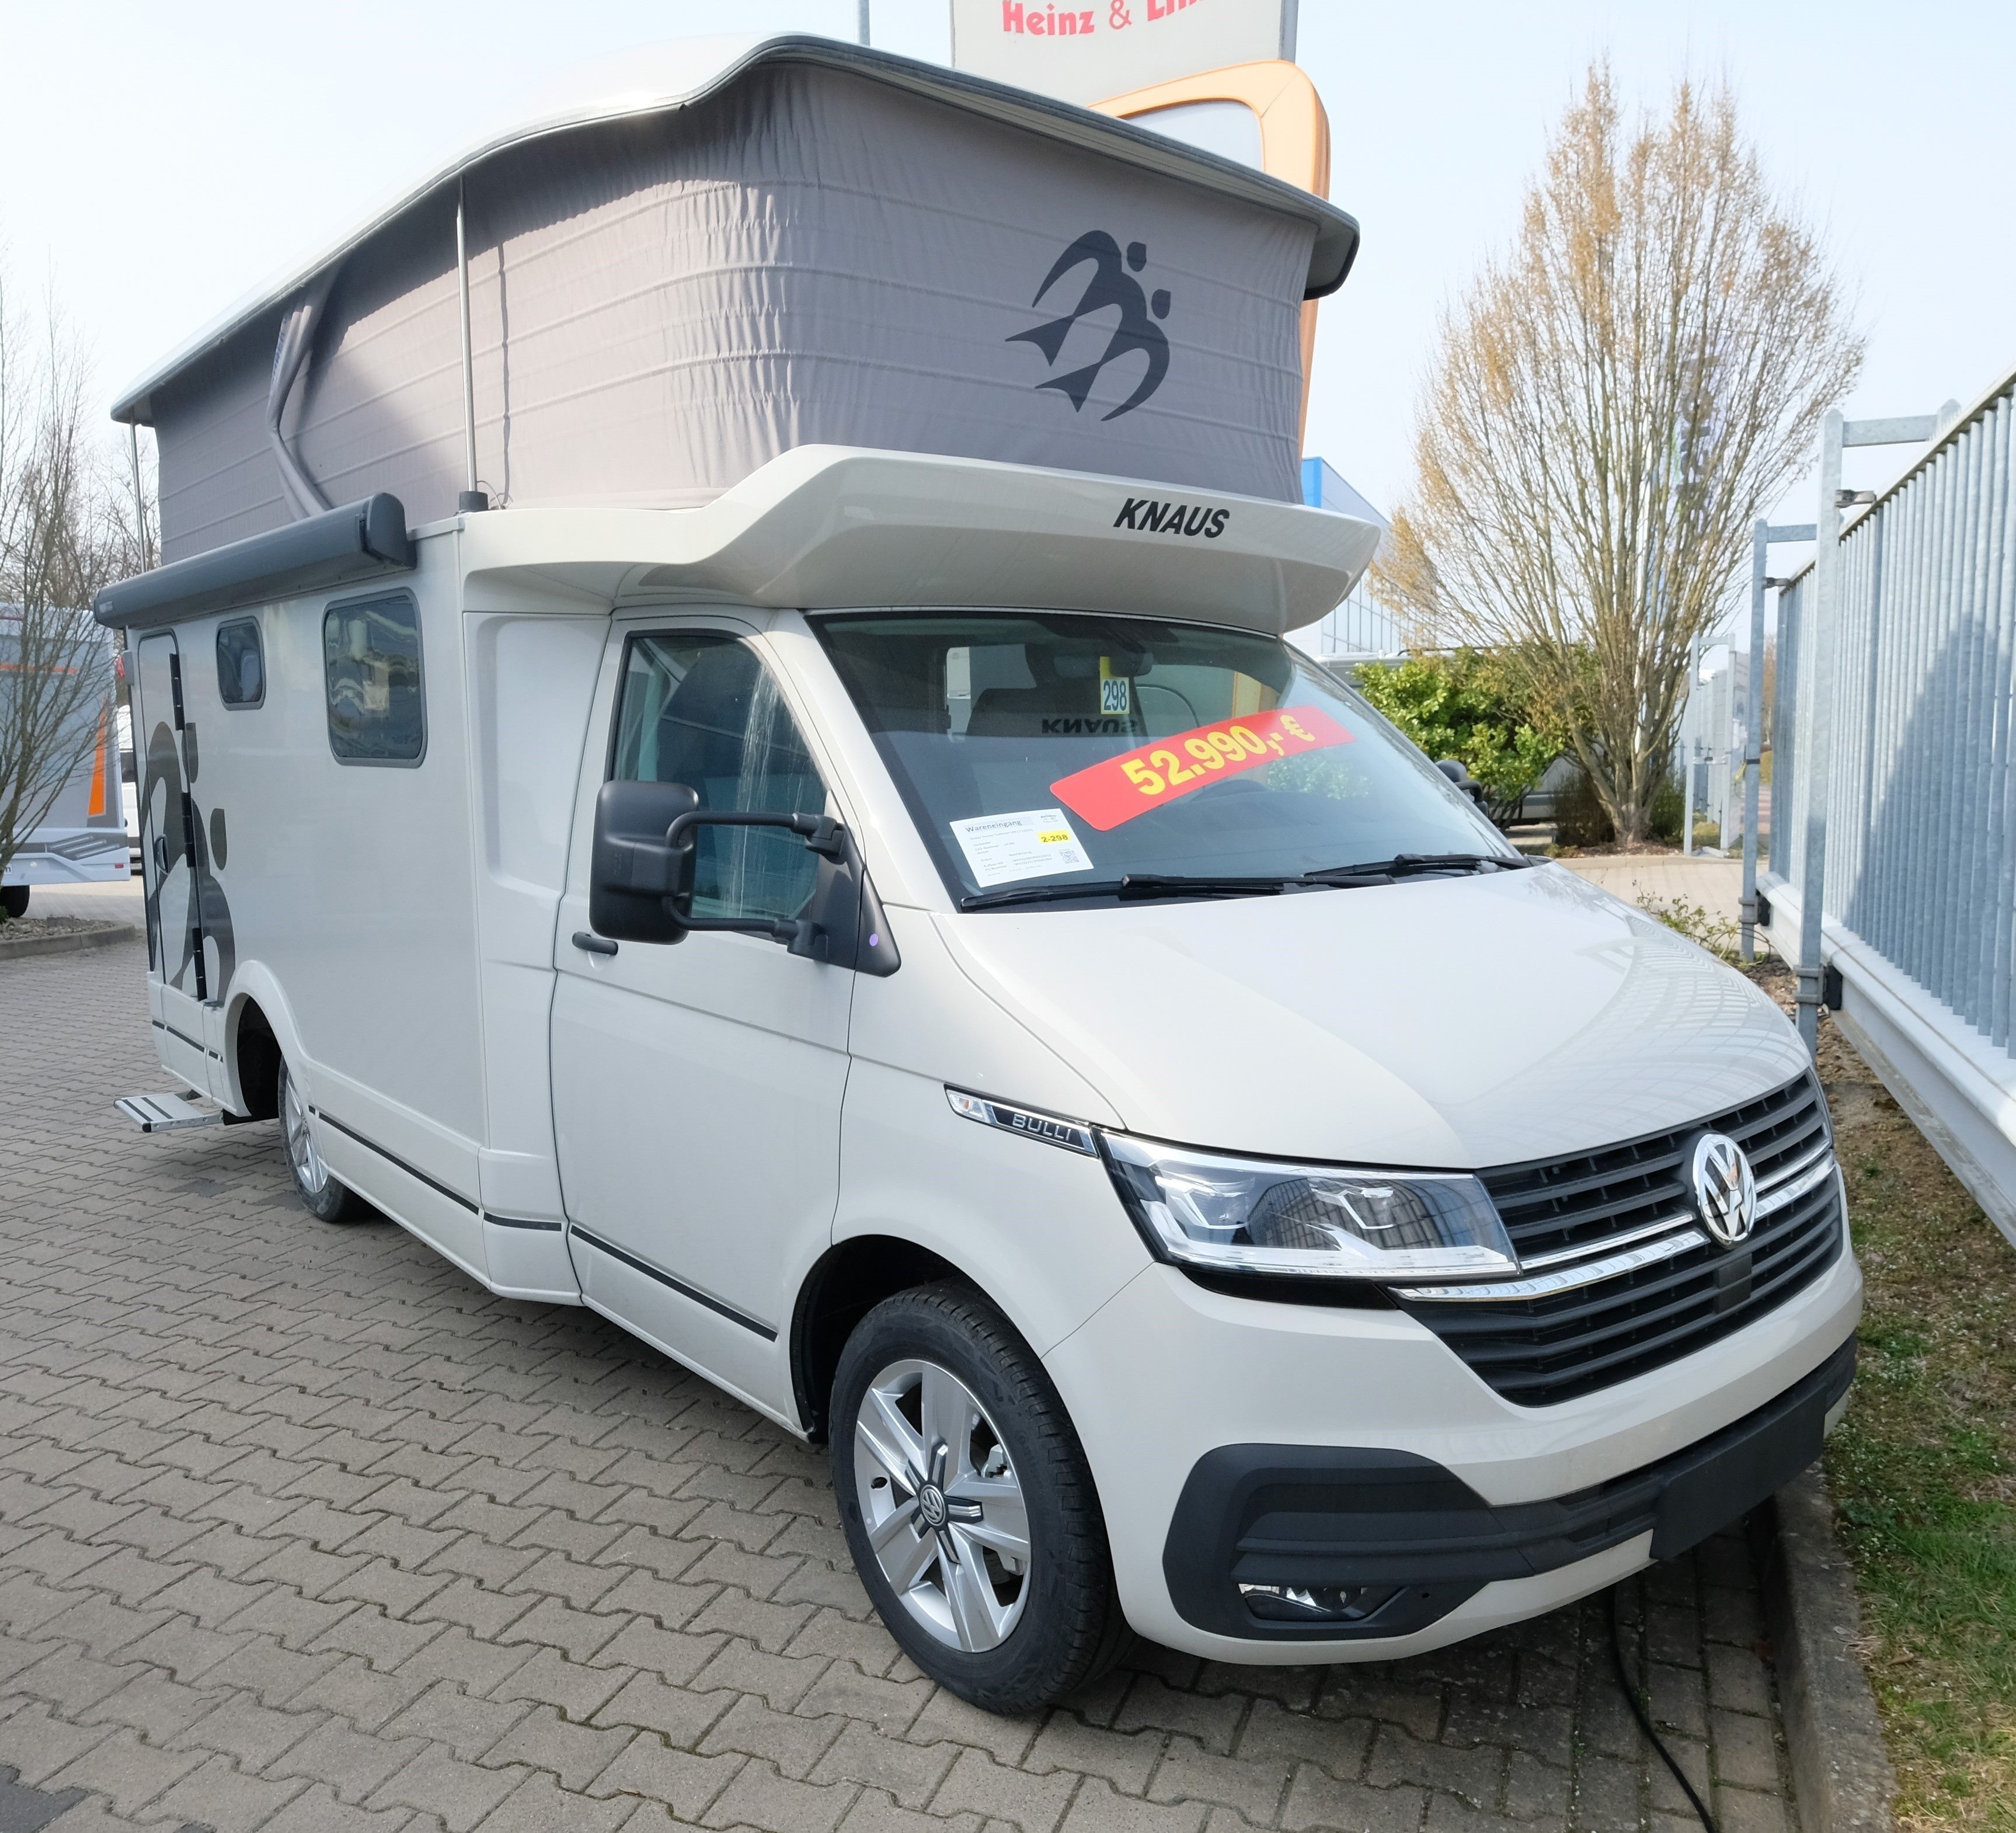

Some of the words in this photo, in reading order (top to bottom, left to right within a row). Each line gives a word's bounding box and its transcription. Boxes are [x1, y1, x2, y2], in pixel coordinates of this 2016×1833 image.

[1002, 0, 1095, 36] Heinz
[1109, 0, 1132, 30] &
[1113, 498, 1230, 538] KNAUS
[1103, 680, 1127, 711] 298
[1120, 725, 1284, 795] 52.990,-
[1280, 715, 1316, 742] €
[965, 820, 1023, 832] Wareneingang
[1041, 834, 1068, 843] 2-298
[1012, 1114, 1071, 1141] BULLI
